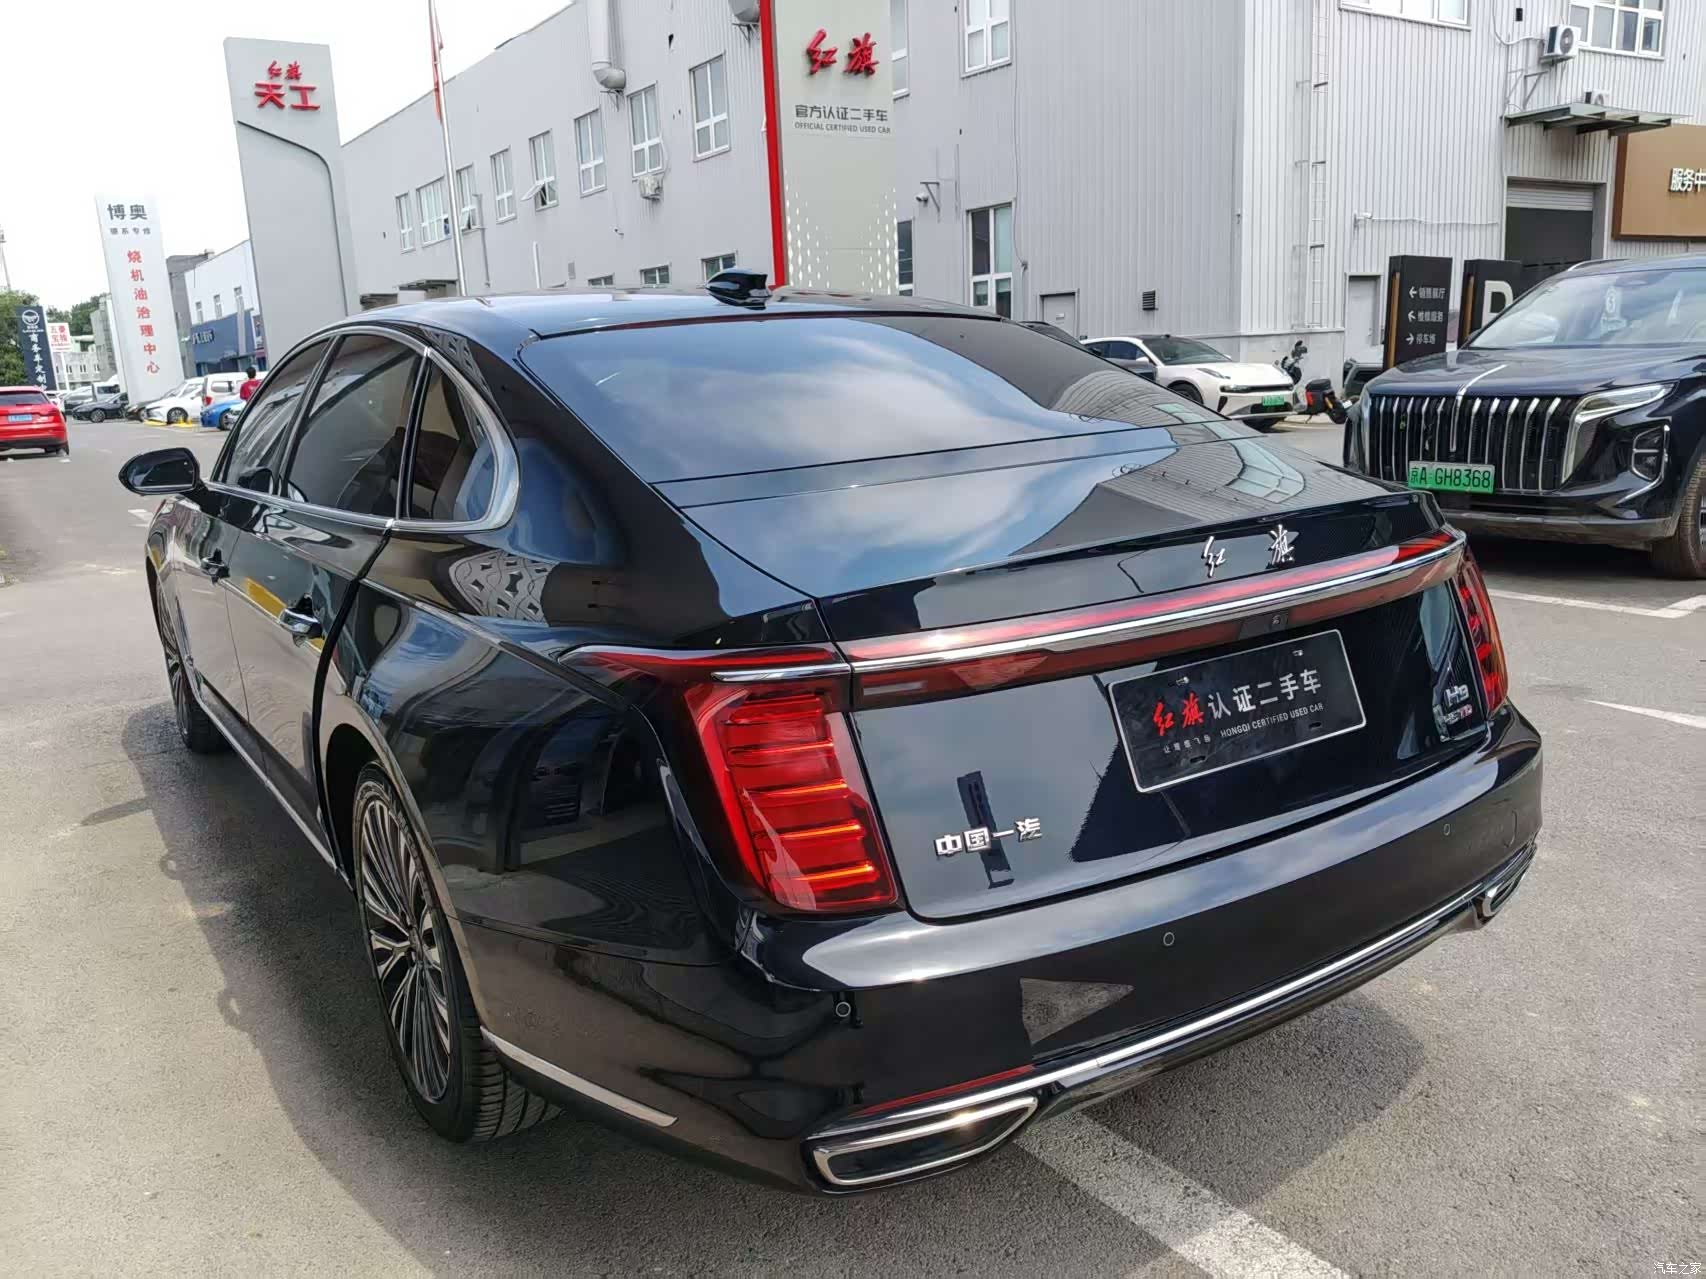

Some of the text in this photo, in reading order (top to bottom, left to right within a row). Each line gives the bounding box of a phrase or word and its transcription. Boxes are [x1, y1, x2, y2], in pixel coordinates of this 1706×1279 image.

[806, 29, 879, 76] 红旗
[268, 60, 302, 80] 红旗
[254, 82, 320, 111] 天工
[795, 105, 888, 121] 官方认证二手车
[795, 122, 891, 134] OFFICIAL CERTIFIED USED CAR
[107, 204, 148, 220] 博奥
[127, 250, 160, 374] 烧机油治理中心
[1416, 333, 1436, 344] 停车场
[1203, 524, 1294, 577] 红旗
[1220, 702, 1324, 738] HONGQI CERTIFIED USED CAR
[935, 817, 1042, 857] 中国一汽
